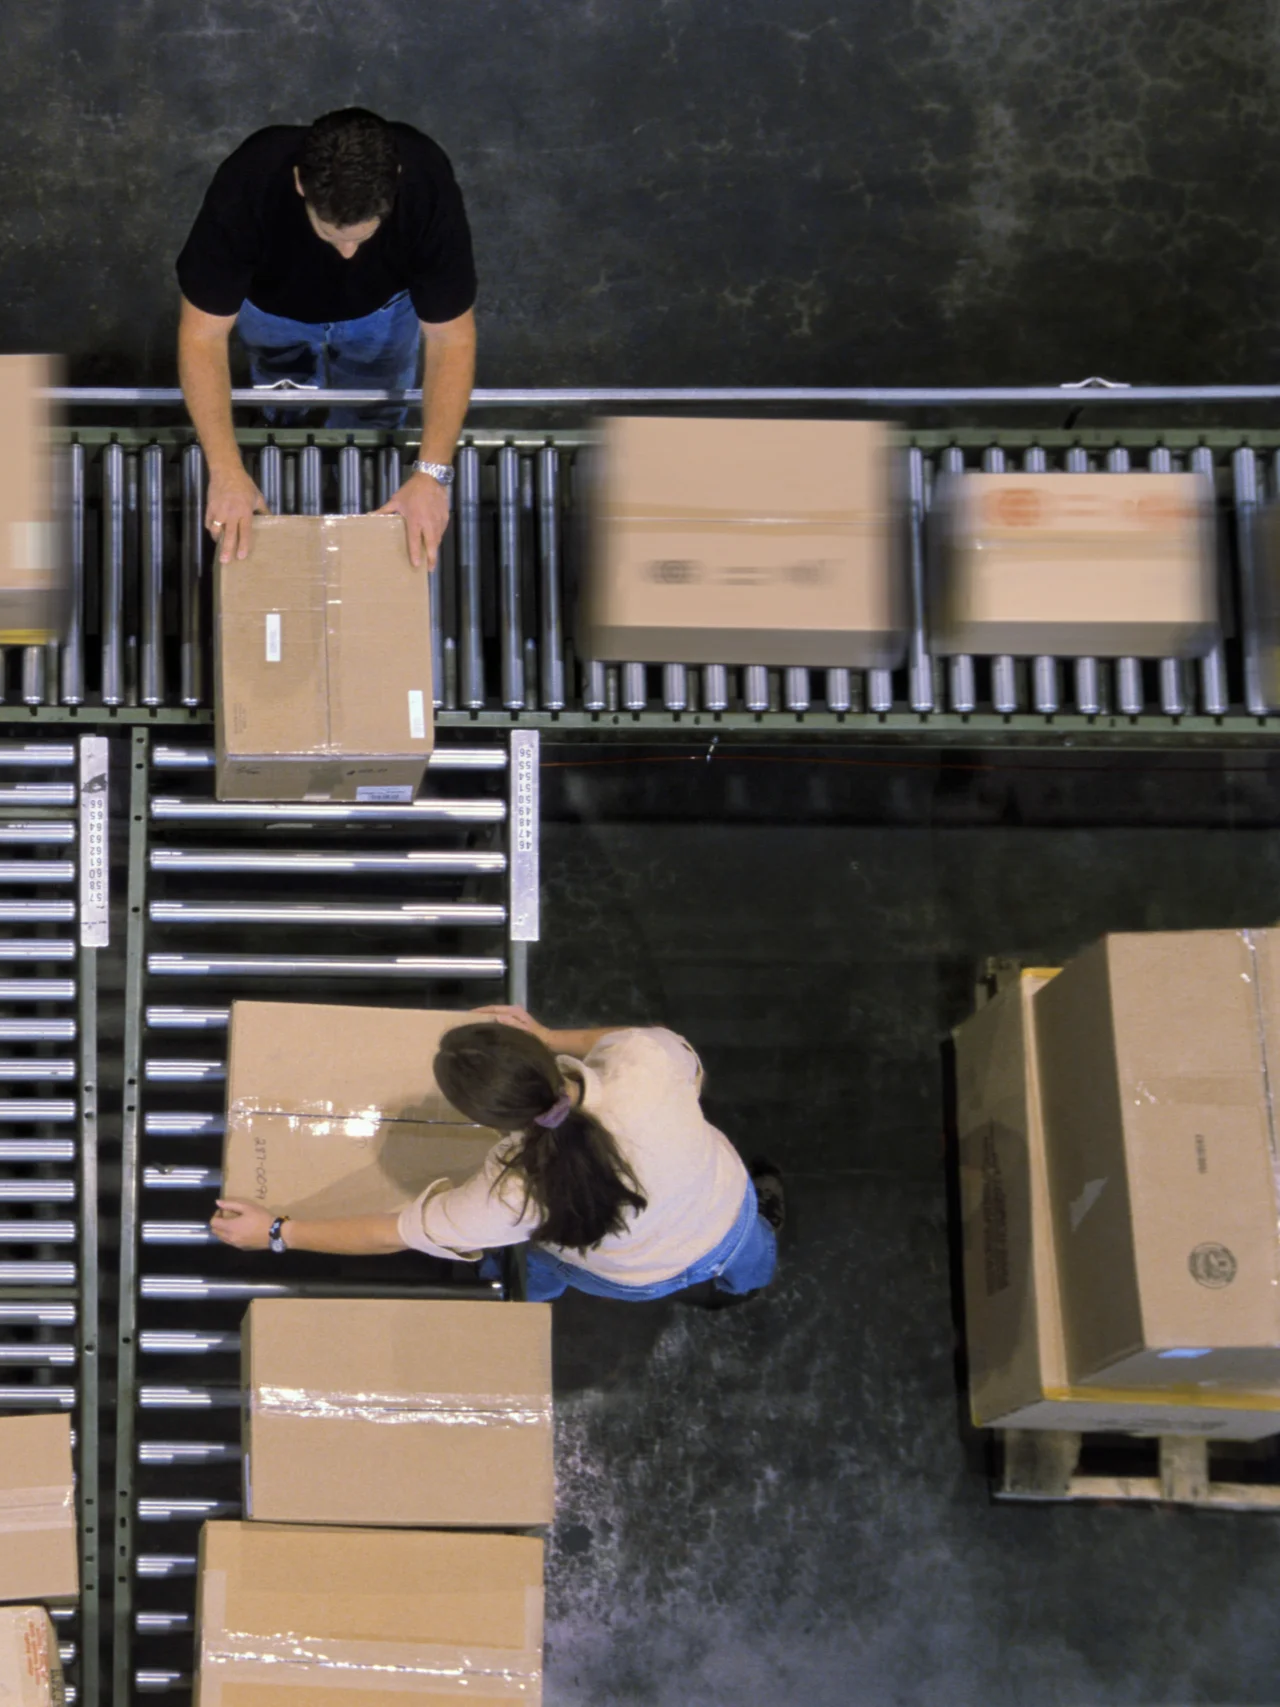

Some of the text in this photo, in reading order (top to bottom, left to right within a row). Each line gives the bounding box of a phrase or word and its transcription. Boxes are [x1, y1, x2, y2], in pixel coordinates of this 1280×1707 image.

[519, 749, 532, 758] 56
[518, 761, 531, 770] 55
[519, 773, 531, 781] 54
[519, 784, 531, 792] 51
[519, 795, 531, 804] 50
[91, 800, 103, 809] 66
[91, 811, 103, 820] 65
[519, 807, 531, 816] 49
[519, 818, 531, 827] 48
[90, 823, 102, 832] 64
[90, 835, 102, 843] 63
[519, 830, 531, 839] 47
[519, 841, 531, 850] 46
[90, 846, 102, 855] 62
[90, 858, 102, 867] 61
[89, 869, 102, 878] 60
[90, 881, 102, 890] 58
[90, 893, 102, 902] 57
